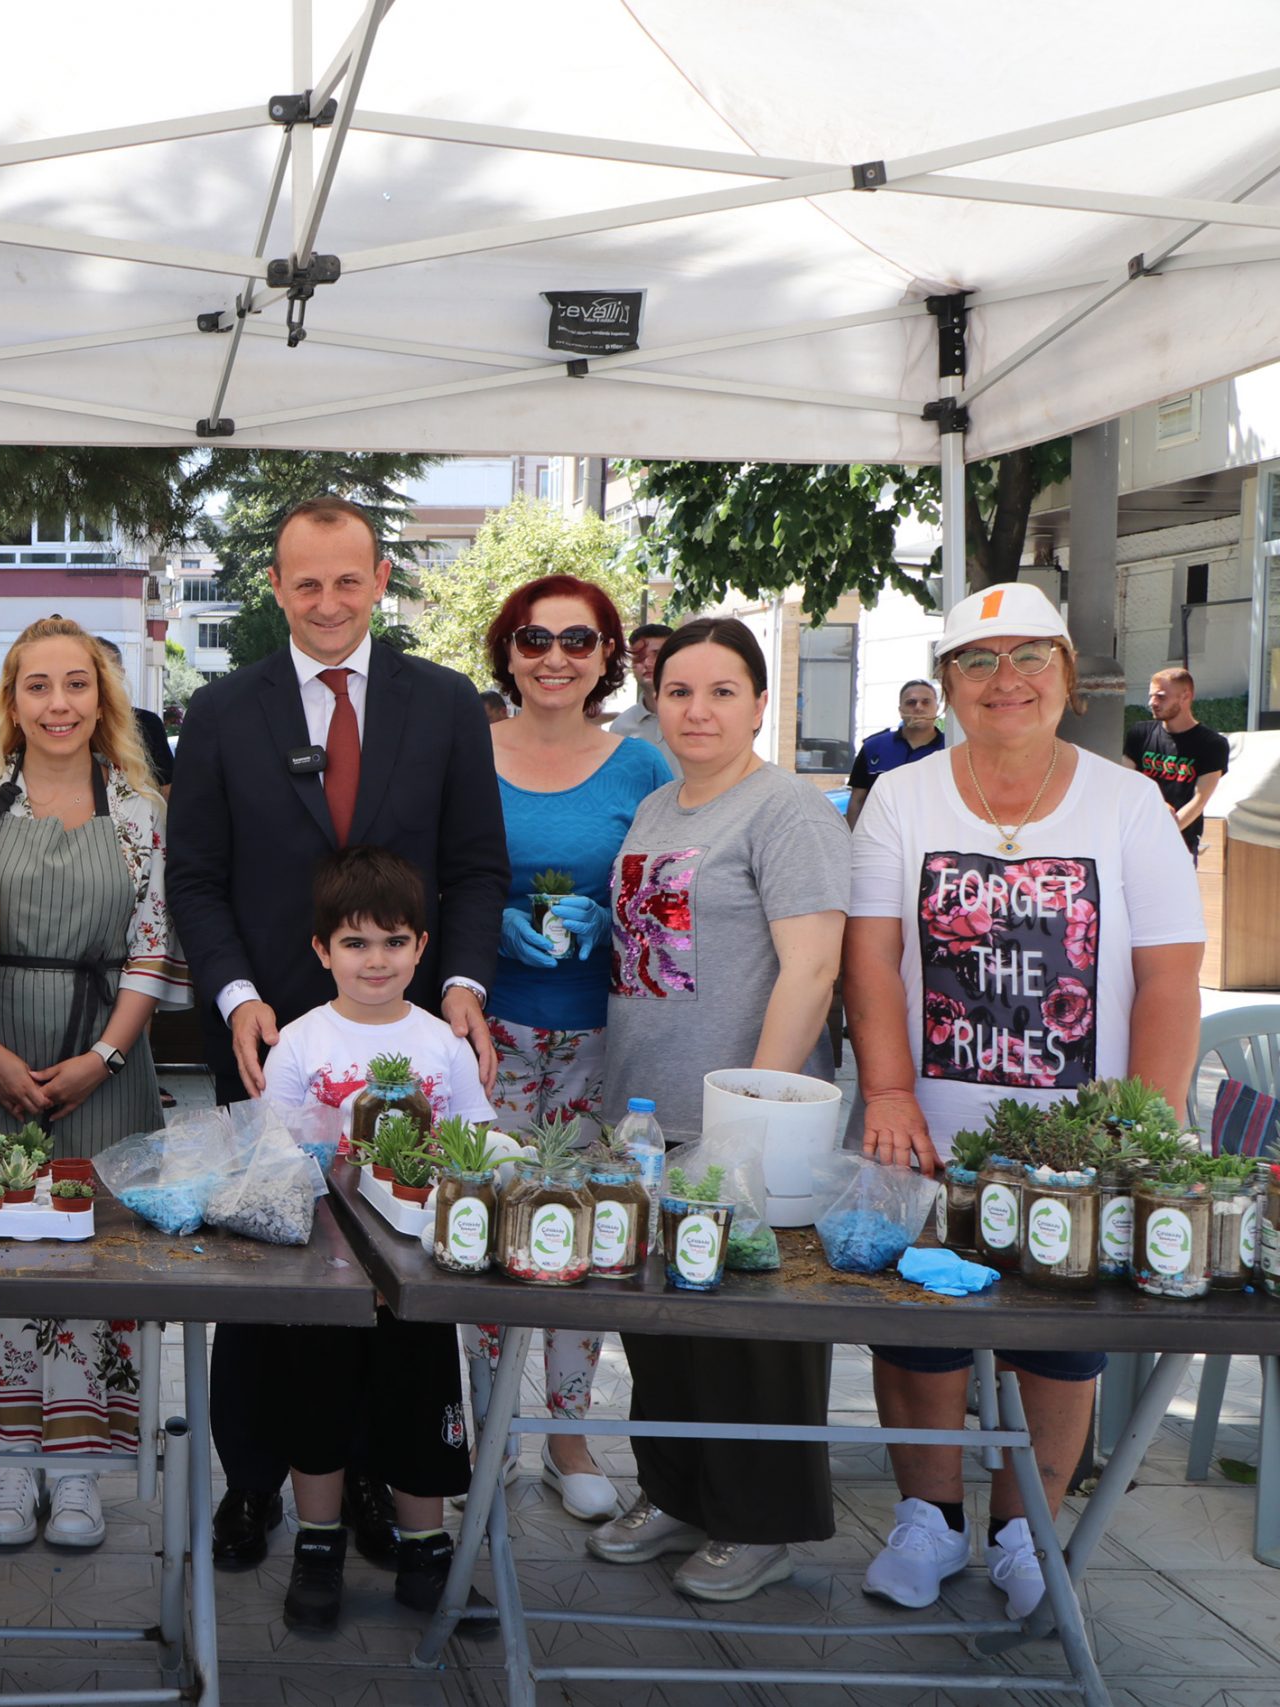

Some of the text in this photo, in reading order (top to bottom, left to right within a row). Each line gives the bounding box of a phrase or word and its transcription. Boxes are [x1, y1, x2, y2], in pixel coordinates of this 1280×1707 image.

[557, 301, 622, 319] tevalli
[937, 867, 1079, 919] FORGET
[970, 945, 1044, 996] THE
[953, 1020, 1066, 1077] RULES
